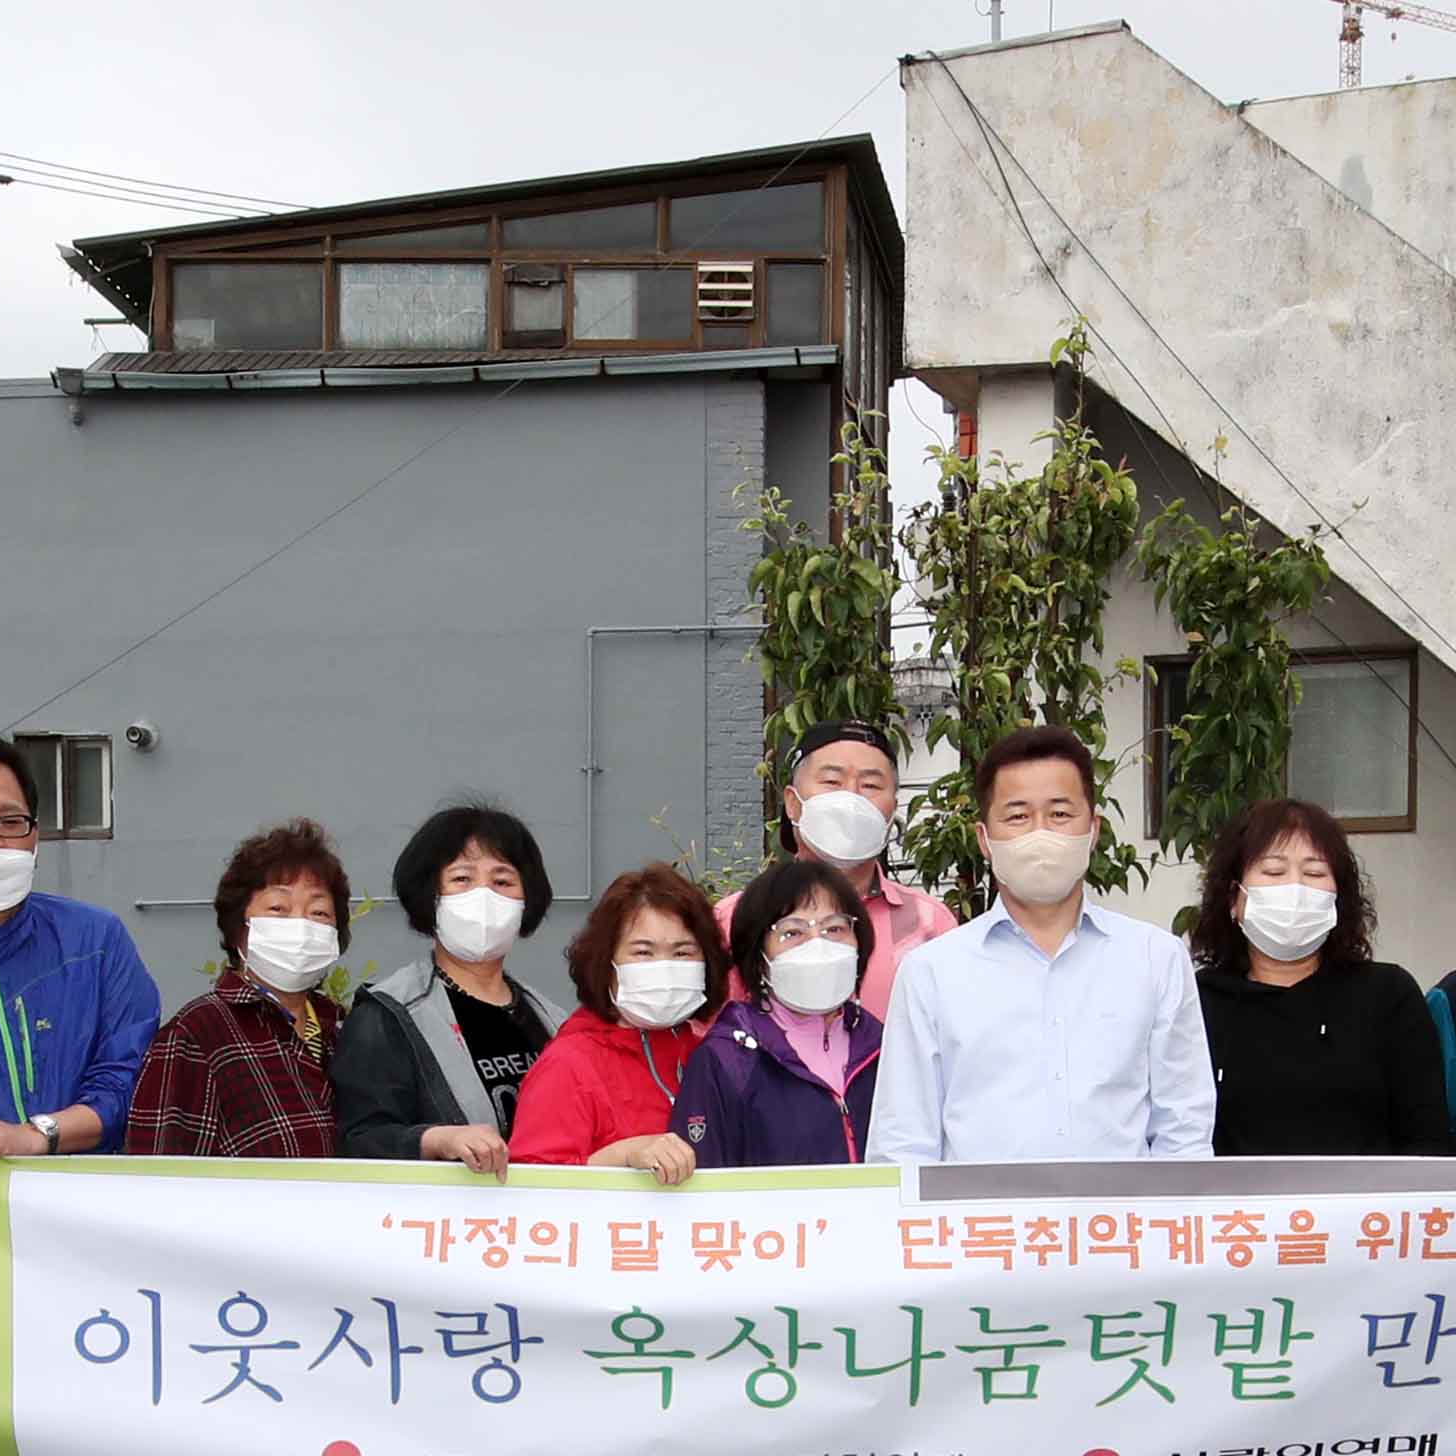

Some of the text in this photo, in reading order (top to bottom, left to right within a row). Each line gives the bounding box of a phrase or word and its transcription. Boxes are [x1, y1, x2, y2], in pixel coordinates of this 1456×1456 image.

[477, 1051, 538, 1080] BREA
[607, 1221, 662, 1271] 달
[898, 1209, 1330, 1270] 단독취약계층을
[74, 1289, 544, 1404] 이웃사랑
[583, 1297, 1314, 1408] 옥상나눔텃밭
